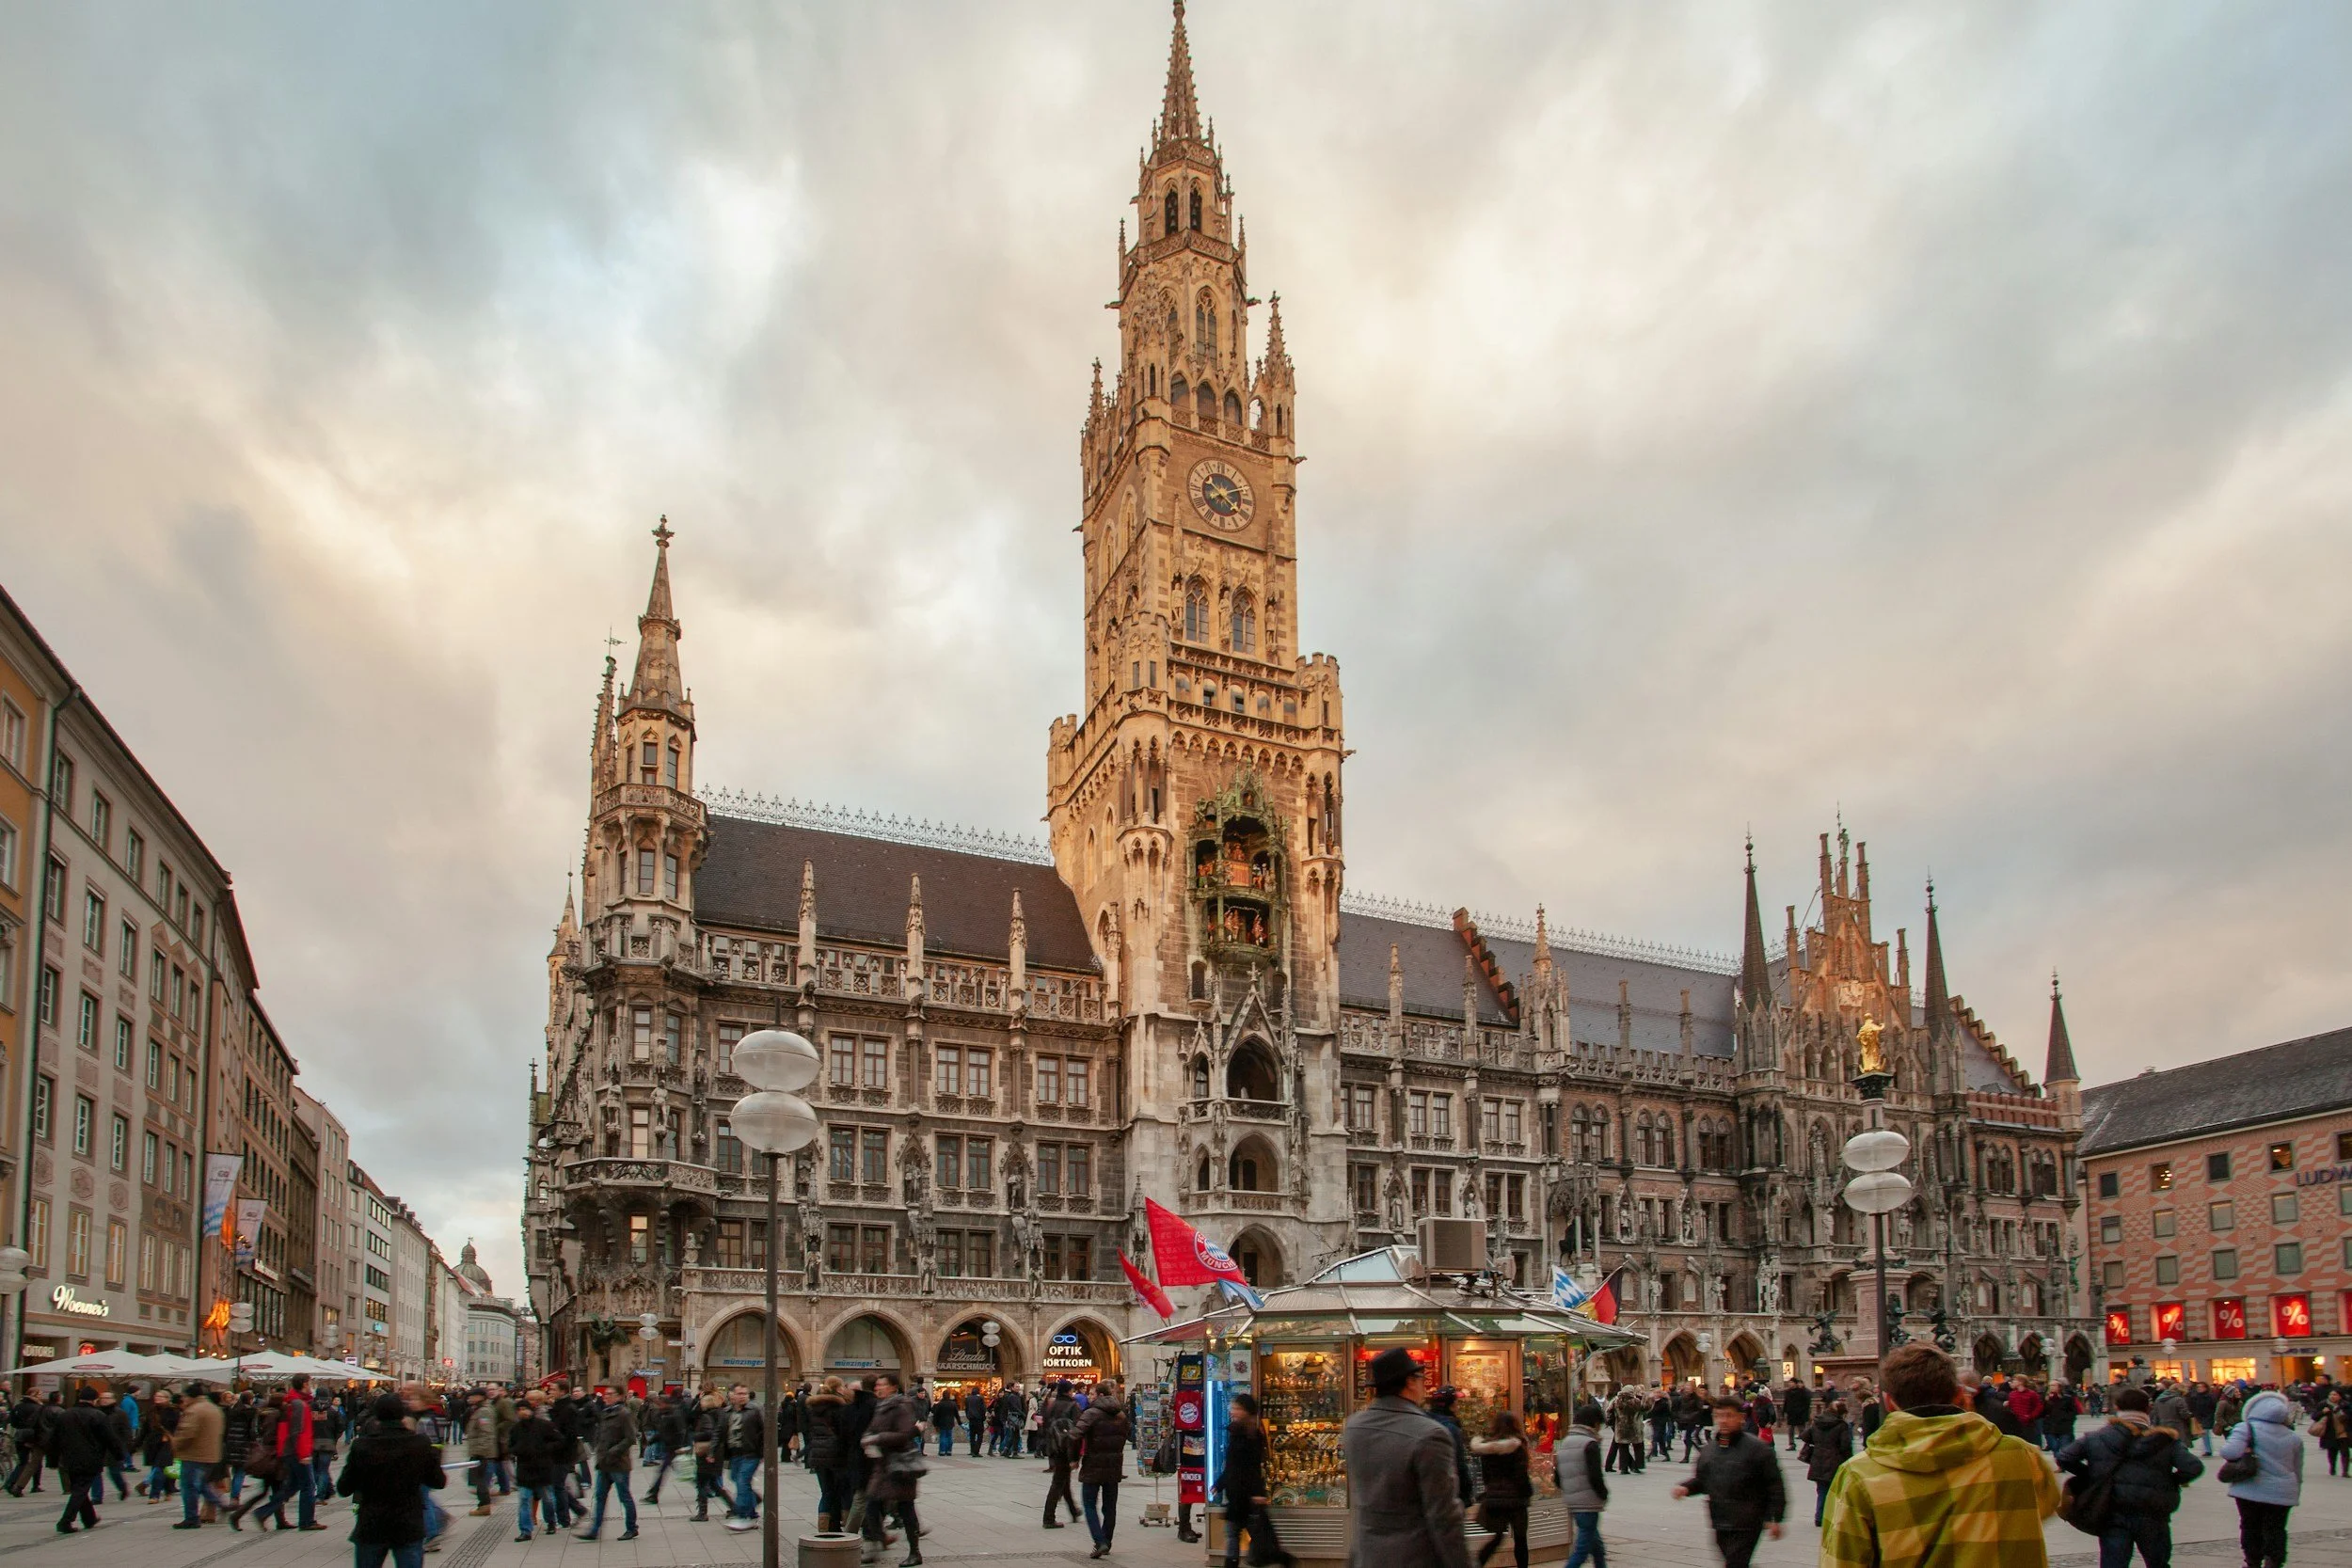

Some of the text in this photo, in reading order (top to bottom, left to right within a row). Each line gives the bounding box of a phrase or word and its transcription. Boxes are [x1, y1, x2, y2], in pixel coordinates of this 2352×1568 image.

[947, 1347, 986, 1362] Linda
[1049, 1346, 1082, 1355] OPTIK
[723, 1358, 765, 1367] münzinger
[834, 1359, 873, 1368] münzinger
